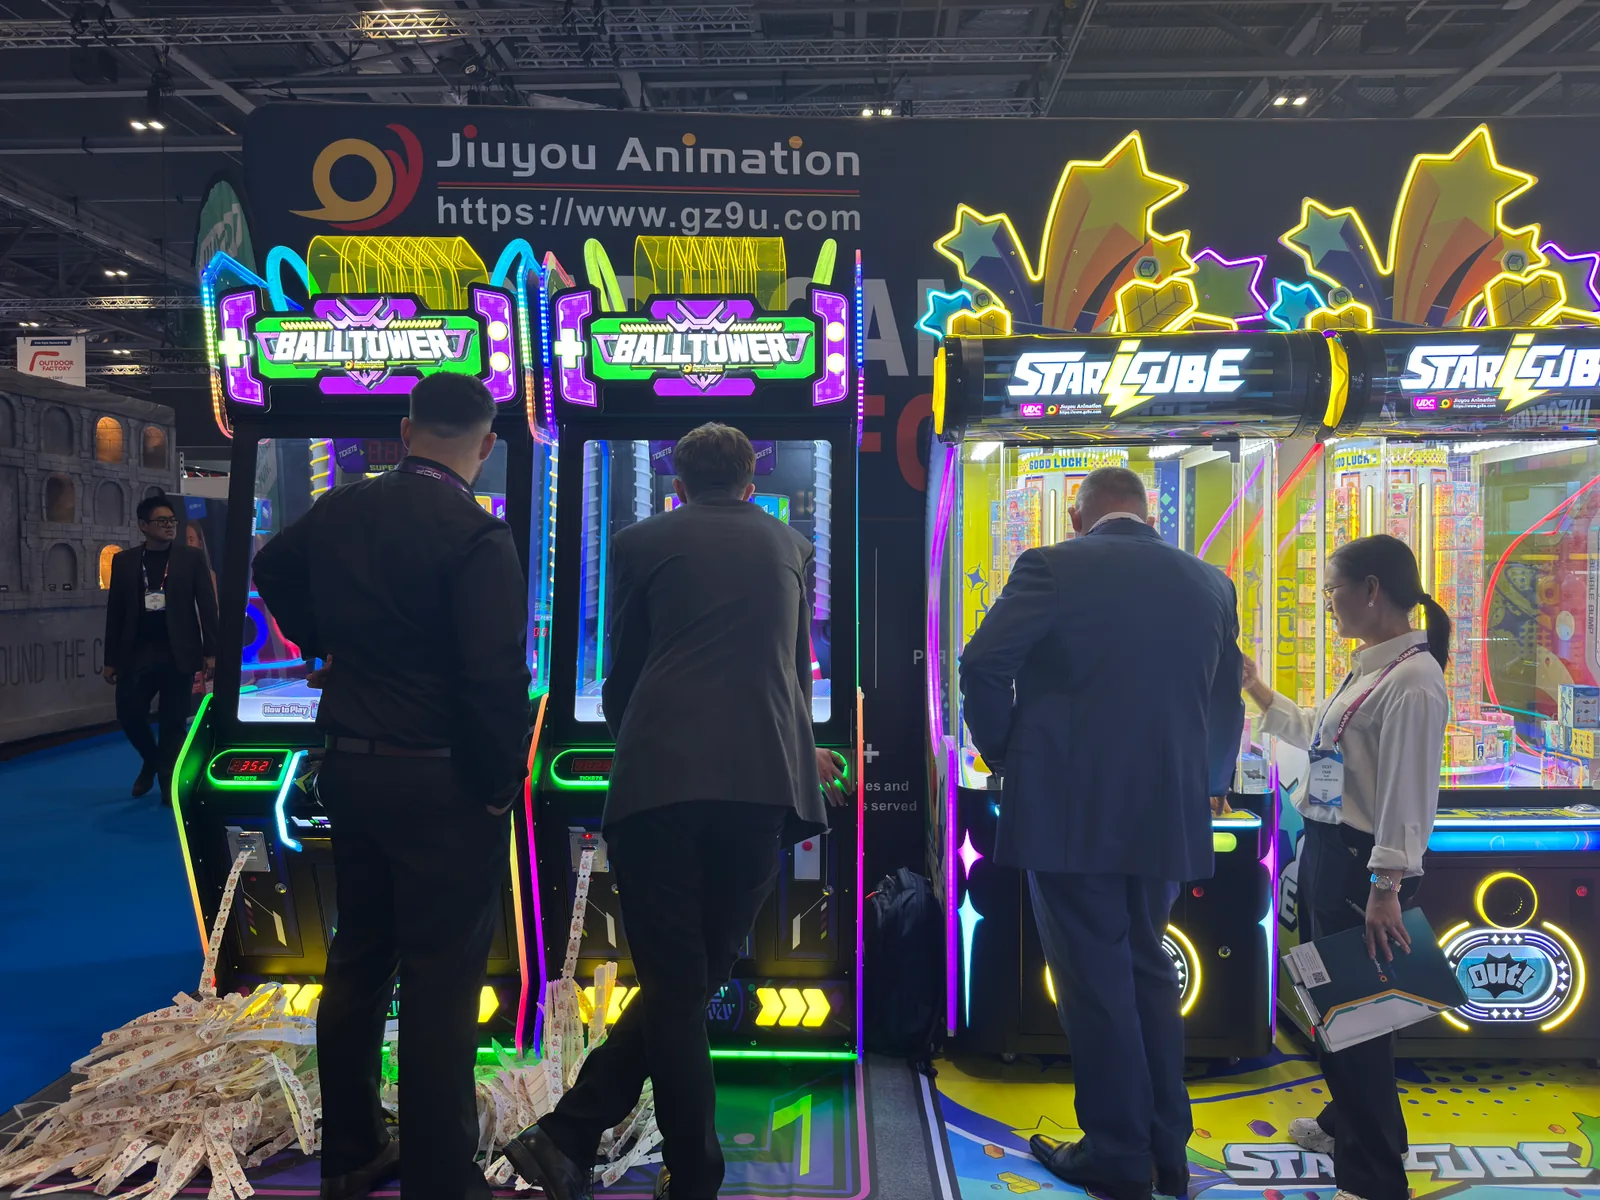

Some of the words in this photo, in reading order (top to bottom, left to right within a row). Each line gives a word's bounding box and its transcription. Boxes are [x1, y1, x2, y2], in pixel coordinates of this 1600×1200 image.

[437, 124, 596, 177] Jiuyou
[616, 132, 860, 176] Animation
[437, 196, 861, 236] https://www.gz9u.com
[272, 329, 455, 361] BALLTOWER
[611, 333, 794, 363] BALLTOWER
[338, 444, 358, 459] TICKETS
[652, 446, 672, 461] TICKETS
[1029, 458, 1051, 470] GOOD
[1054, 457, 1088, 469] LUCK!
[53, 637, 86, 682] THE
[263, 705, 281, 714] How
[281, 705, 290, 714] to
[290, 704, 308, 716] Play
[240, 760, 270, 772] 352
[884, 780, 909, 791] and
[871, 801, 918, 812] served
